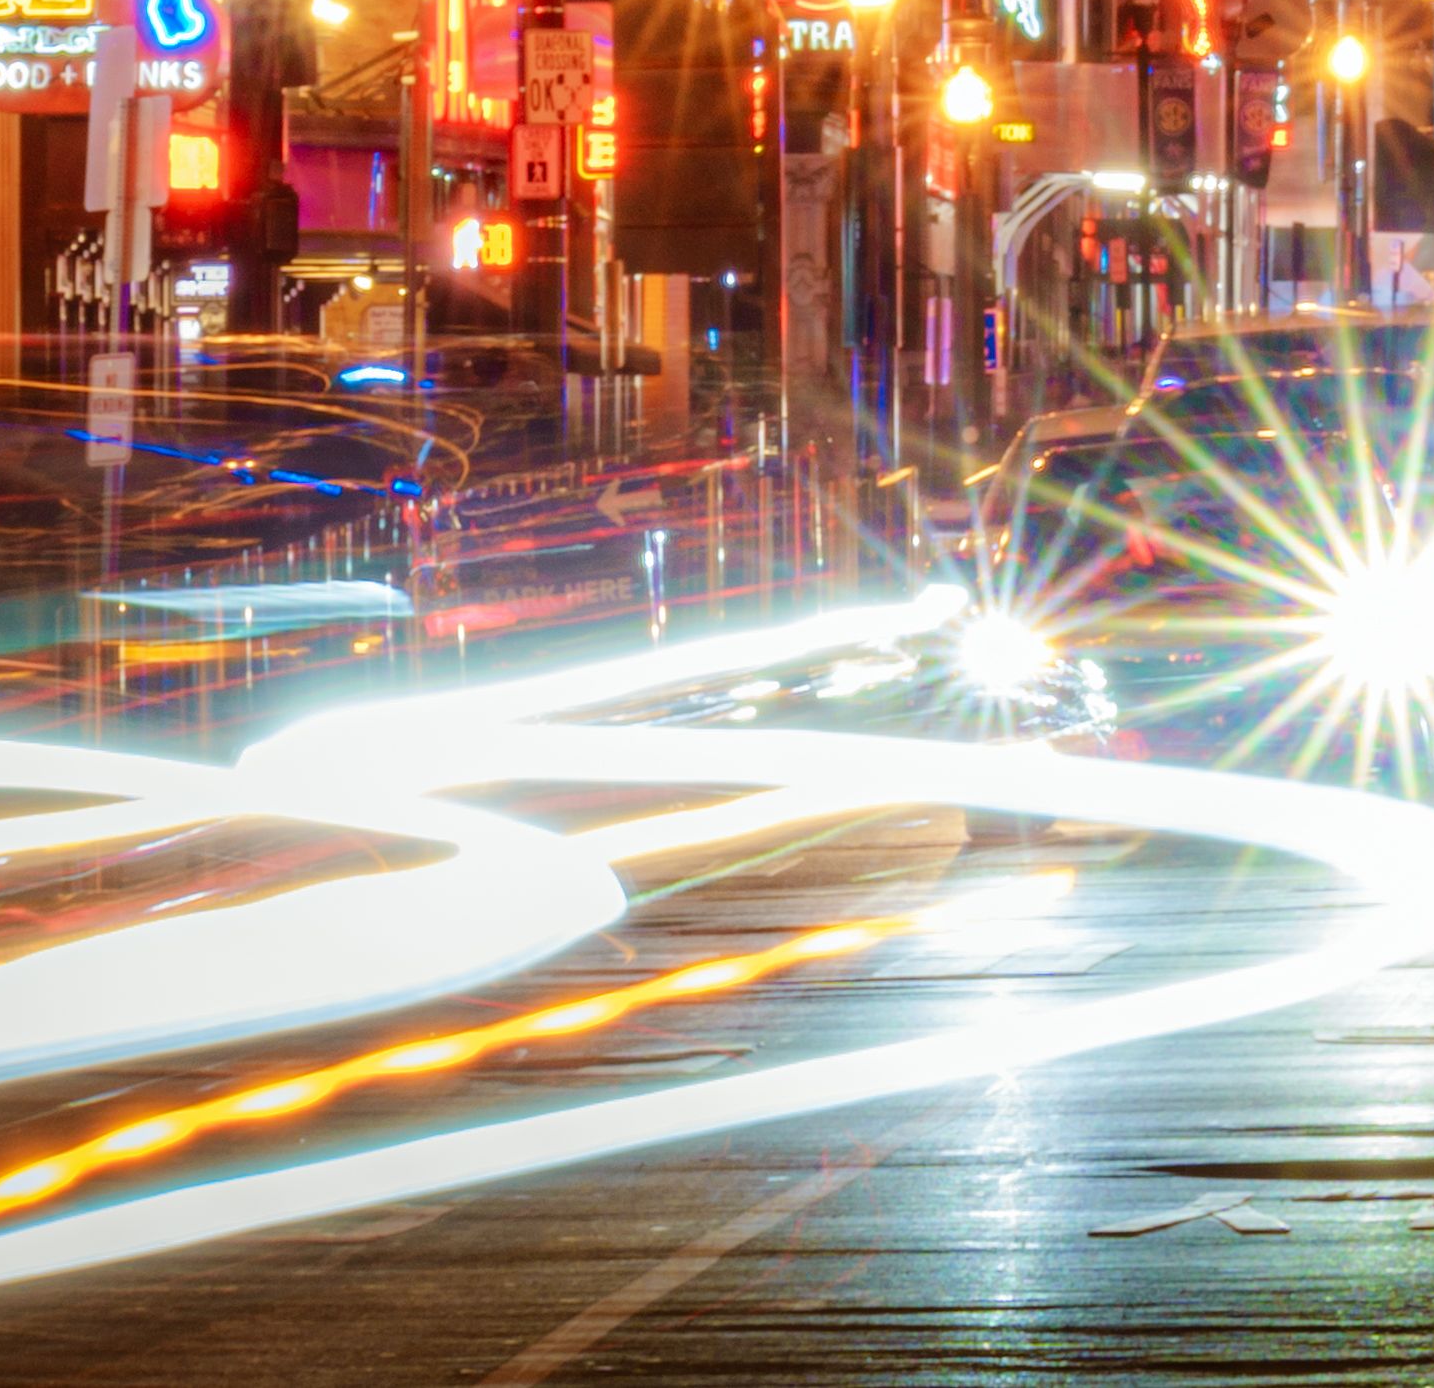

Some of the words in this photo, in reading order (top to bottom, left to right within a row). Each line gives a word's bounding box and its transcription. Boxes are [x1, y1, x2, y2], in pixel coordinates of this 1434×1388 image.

[534, 34, 586, 52] DIAGONAL
[534, 52, 586, 71] CROSSING
[530, 78, 557, 111] OK
